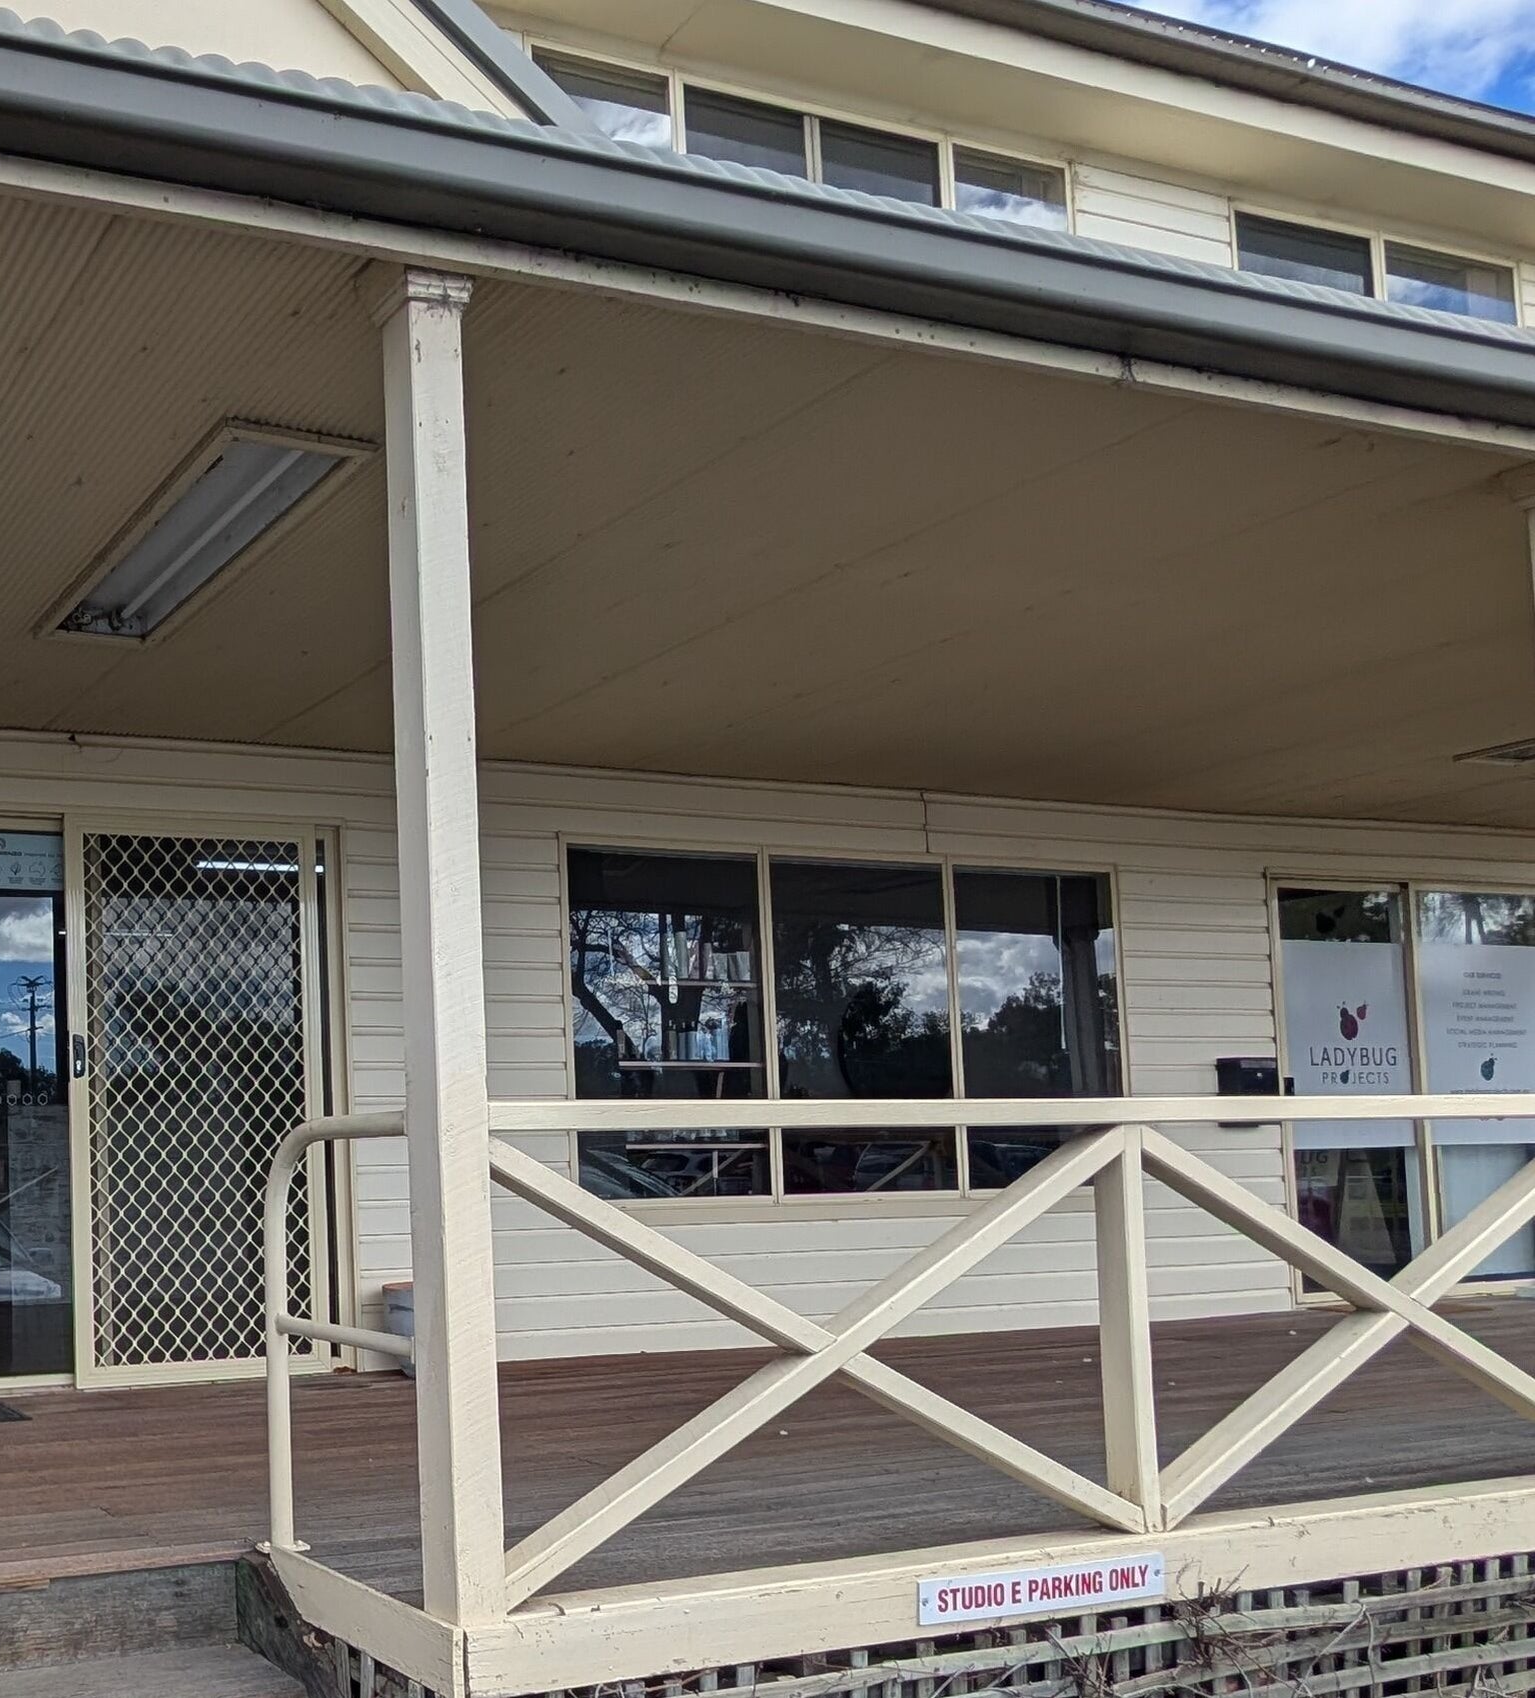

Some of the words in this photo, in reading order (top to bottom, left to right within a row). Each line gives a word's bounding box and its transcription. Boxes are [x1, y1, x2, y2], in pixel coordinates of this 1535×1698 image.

[1309, 1046, 1397, 1066] LADYBUG
[937, 1582, 1005, 1613] STUDIO
[1011, 1581, 1022, 1604] E
[1028, 1570, 1103, 1601] PARKING
[1109, 1564, 1149, 1591] ONLY
